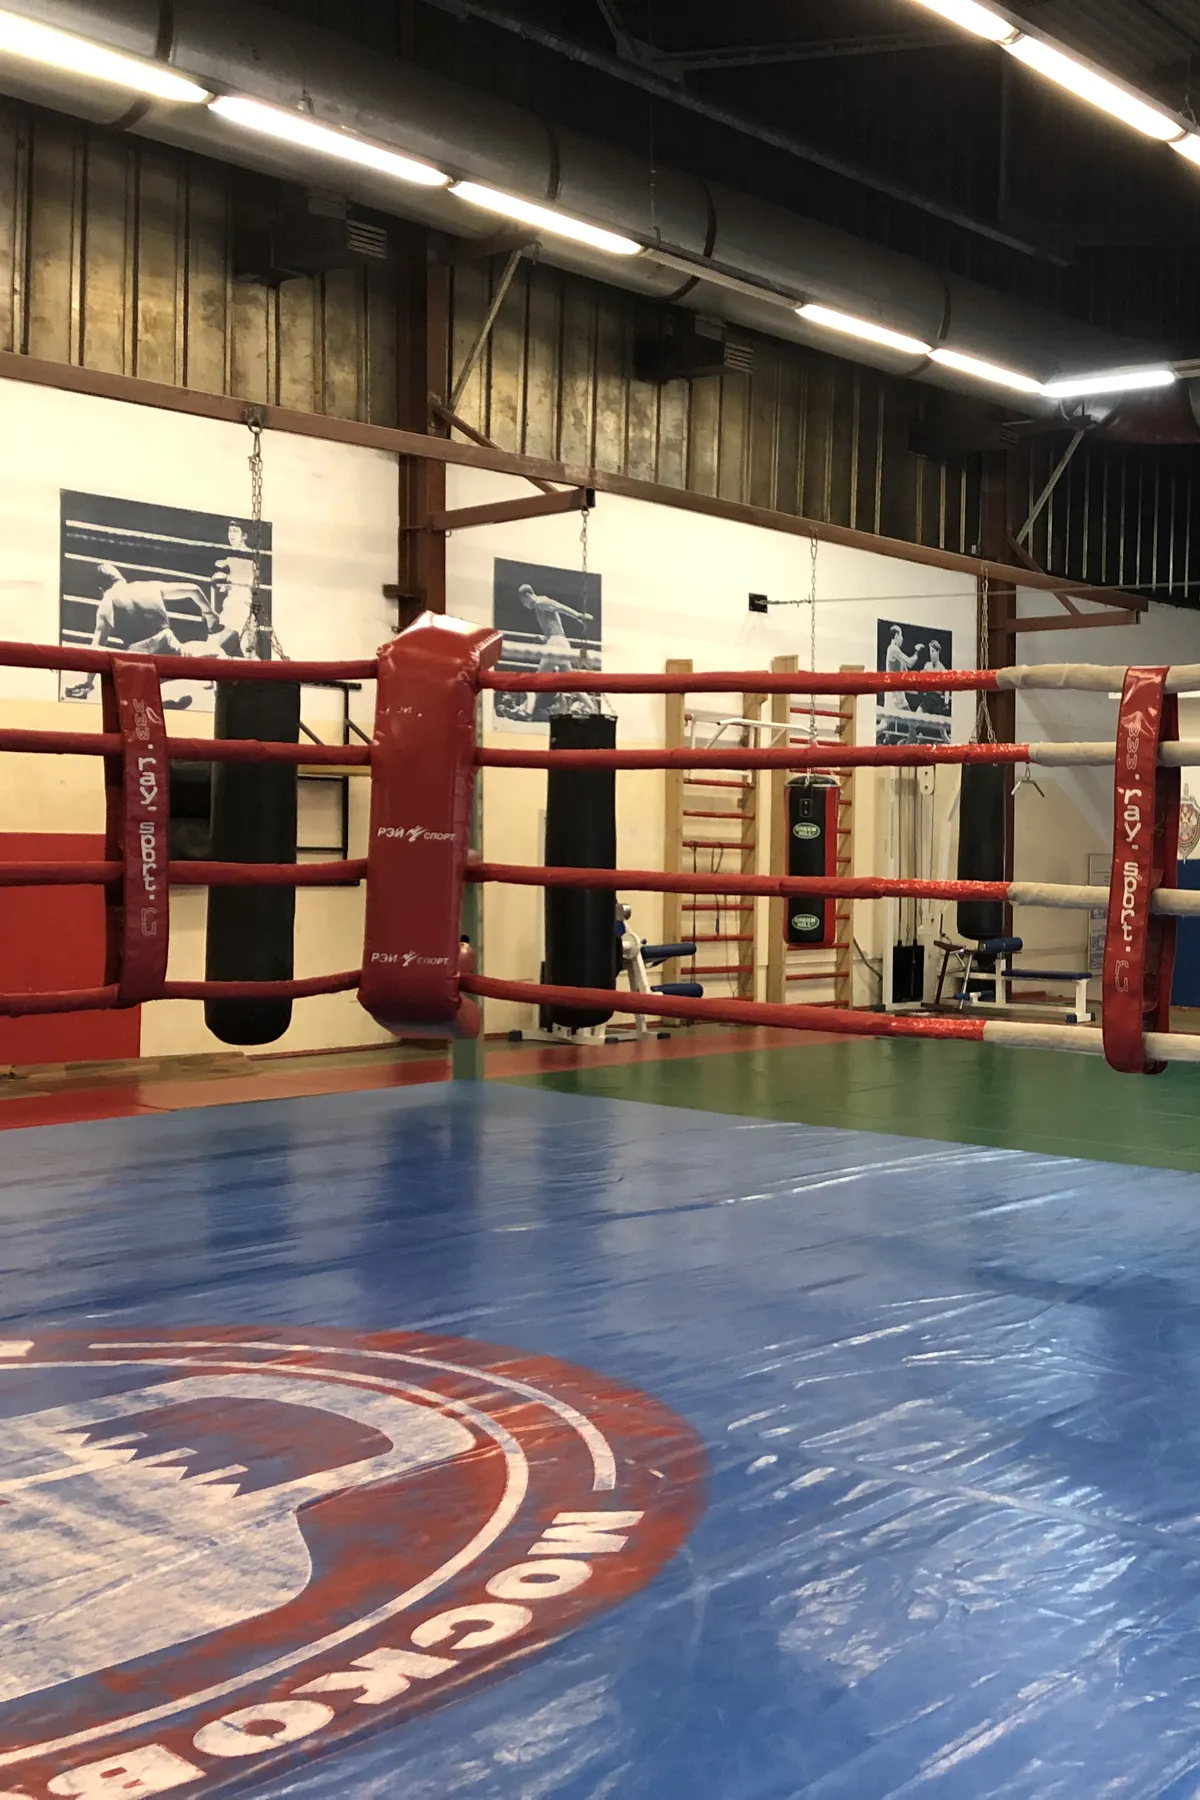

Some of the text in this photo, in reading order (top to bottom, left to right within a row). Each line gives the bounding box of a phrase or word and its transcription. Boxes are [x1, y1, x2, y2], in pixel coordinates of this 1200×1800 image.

[377, 826, 456, 841] РЭЙ СПОРТ
[416, 956, 450, 966] СПОРТ
[0, 1510, 645, 1800] МОСКОВ
